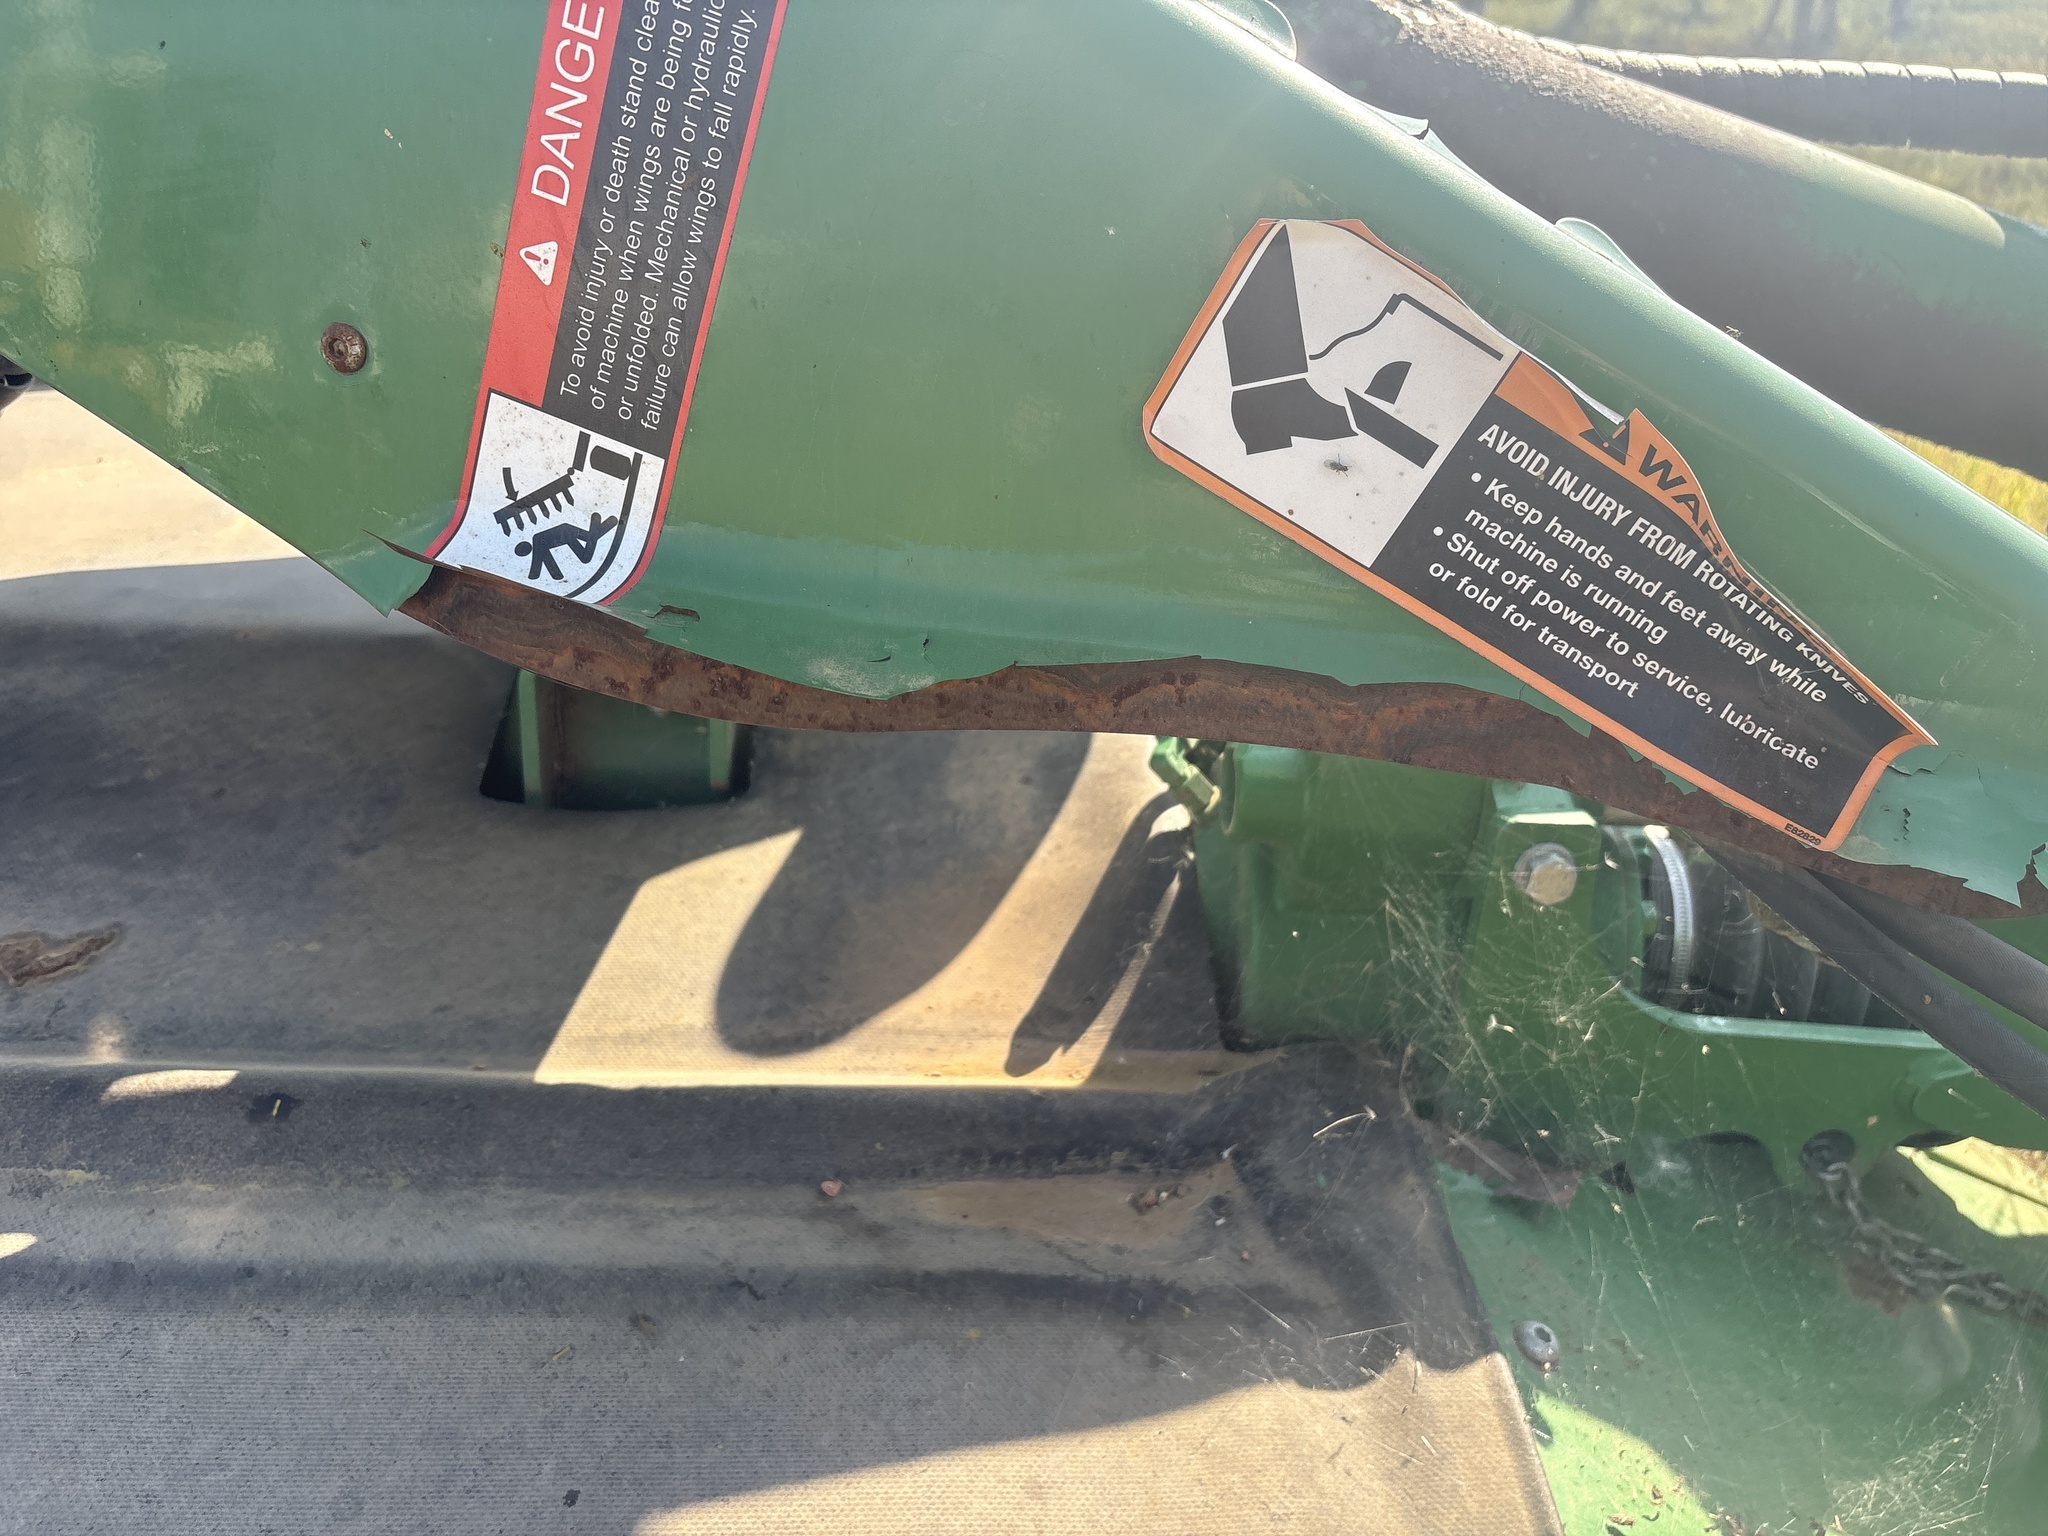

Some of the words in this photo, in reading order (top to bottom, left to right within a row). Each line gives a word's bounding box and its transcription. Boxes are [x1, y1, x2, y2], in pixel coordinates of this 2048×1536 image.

[634, 0, 661, 51] clea
[656, 18, 692, 90] being
[722, 8, 757, 97] rapidly.
[531, 0, 605, 206] DANGE
[620, 57, 648, 128] stand
[650, 97, 671, 138] are
[708, 102, 733, 139] fall
[681, 115, 698, 143] or
[702, 147, 722, 170] to
[603, 135, 632, 202] death
[633, 144, 661, 213] wings
[600, 207, 616, 233] or
[645, 147, 691, 283] Mechanical
[687, 176, 716, 243] wings
[581, 238, 613, 301] injury
[618, 220, 644, 281] when
[671, 250, 698, 310] allow
[571, 306, 595, 367] avoid
[597, 289, 629, 383] machine
[624, 292, 659, 392] unfolded.
[662, 317, 682, 358] can
[560, 373, 581, 396] To
[590, 385, 606, 410] of
[618, 397, 632, 420] or
[641, 364, 671, 430] failure
[1464, 508, 1559, 573] machine
[1560, 564, 1582, 589] is
[1583, 583, 1669, 645] running
[1477, 424, 1550, 478] AVOID
[1547, 465, 1632, 527] INJURY
[1627, 517, 1697, 570] FROM
[1693, 559, 1794, 642] ROTATING
[1795, 642, 1869, 704] KNIVES
[1484, 478, 1543, 526] Keep
[1544, 516, 1613, 569] hands
[1615, 563, 1662, 598] and
[1660, 589, 1708, 627] feet
[1705, 622, 1768, 666] away
[1768, 658, 1827, 702] while
[1429, 562, 1456, 582] or
[1456, 576, 1503, 611] fold
[1501, 604, 1536, 633] for
[1537, 625, 1640, 698] transport
[1447, 532, 1500, 576] Shut
[1501, 570, 1536, 595] off
[1531, 589, 1605, 639] power
[1606, 631, 1629, 656] to
[1632, 651, 1714, 714] service,
[1719, 702, 1819, 769] lubricate
